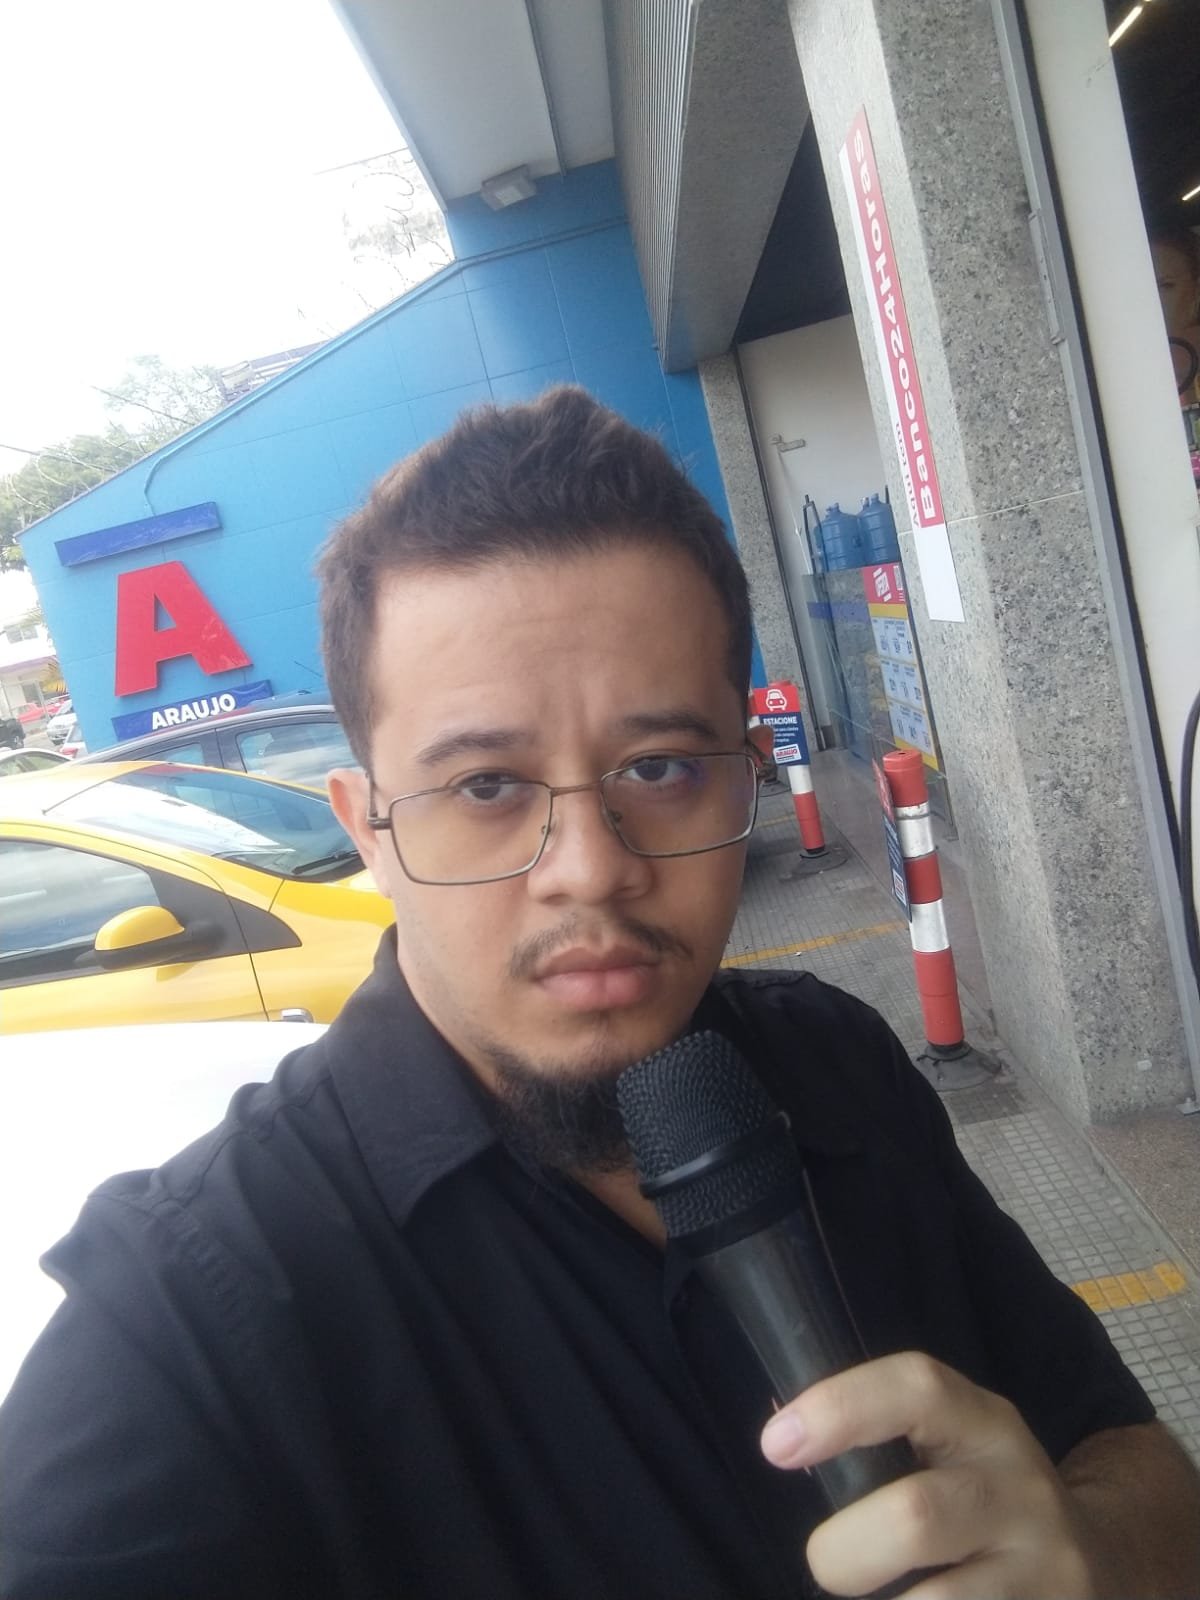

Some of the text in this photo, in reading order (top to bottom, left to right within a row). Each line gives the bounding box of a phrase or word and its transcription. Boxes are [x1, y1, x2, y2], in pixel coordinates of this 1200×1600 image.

[853, 128, 936, 520] Banco24Horas
[895, 422, 919, 526] Aqui tem
[115, 560, 252, 697] A
[152, 694, 236, 730] ARAUJO
[763, 716, 798, 725] ESTACIONE
